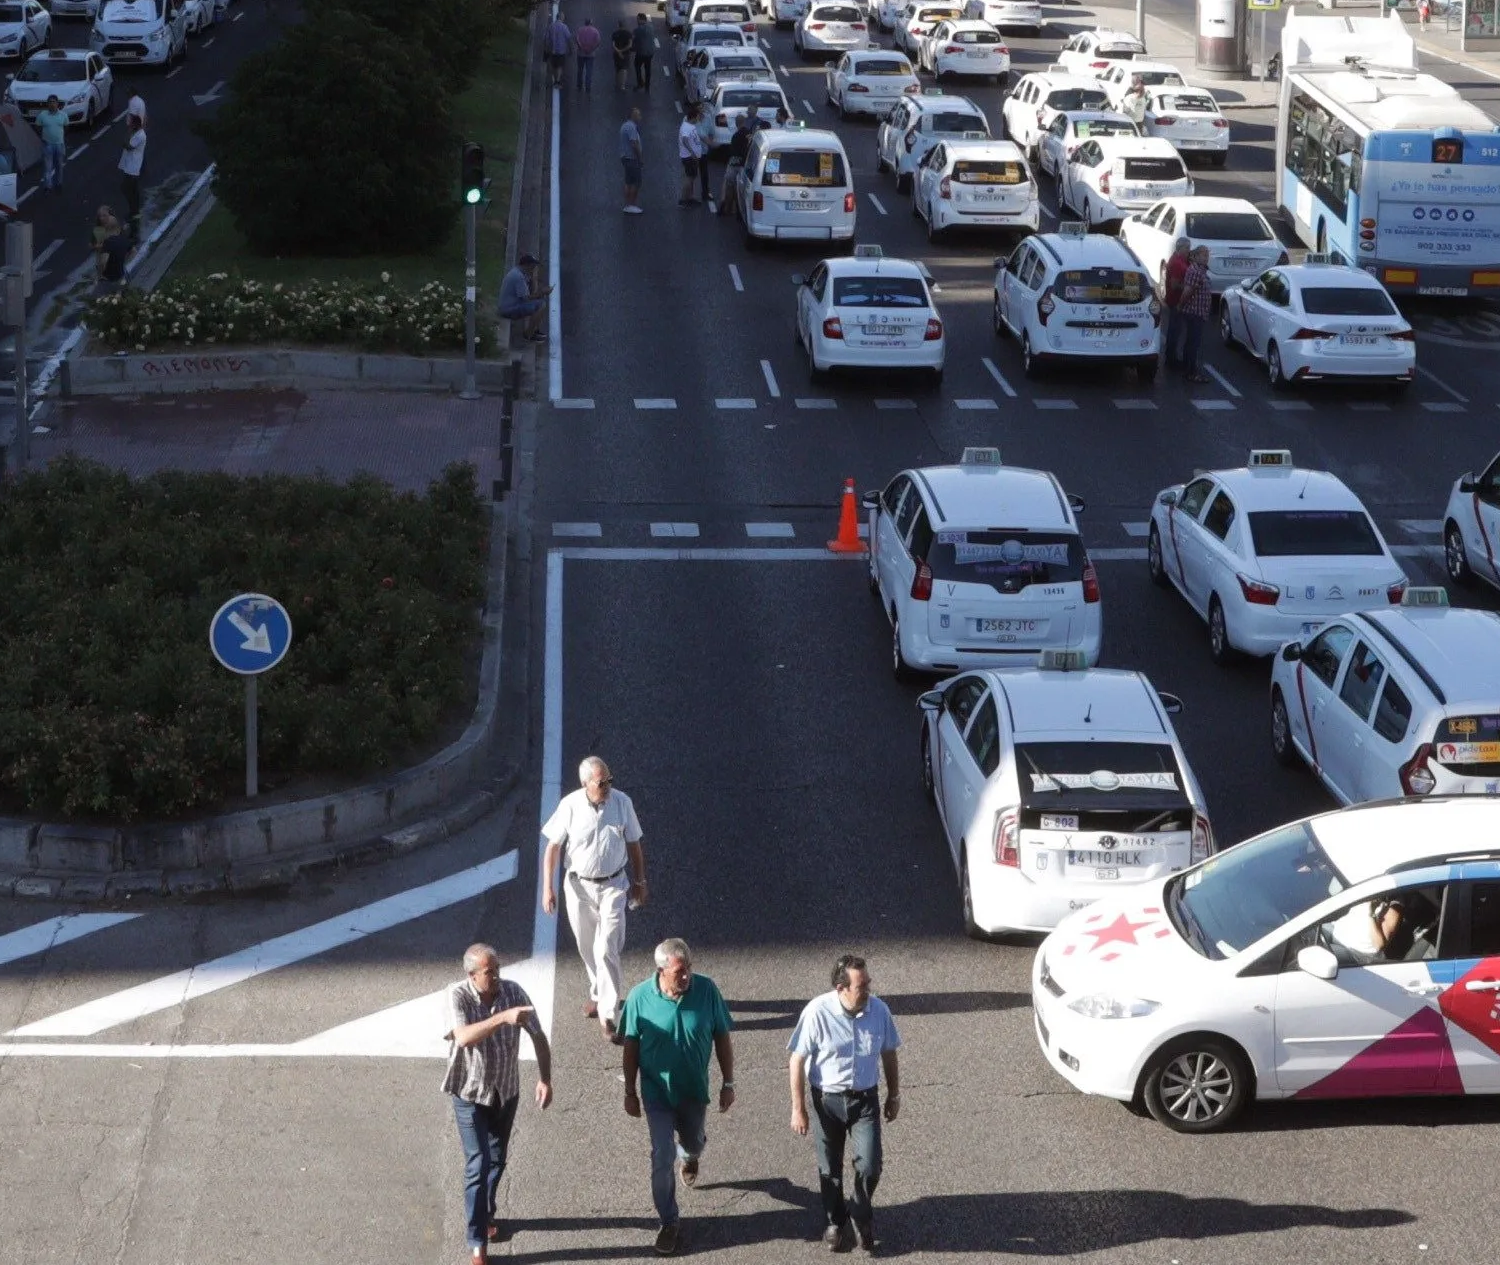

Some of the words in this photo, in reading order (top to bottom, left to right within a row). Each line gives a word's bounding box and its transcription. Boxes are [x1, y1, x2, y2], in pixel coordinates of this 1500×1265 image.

[1437, 145, 1456, 161] 27
[1481, 147, 1499, 157] 512
[948, 584, 956, 596] V
[1285, 586, 1295, 598] L
[983, 618, 1011, 631] 2562
[1015, 618, 1035, 631] JTC
[1077, 850, 1111, 864] 4110
[1116, 851, 1141, 864] HLK
